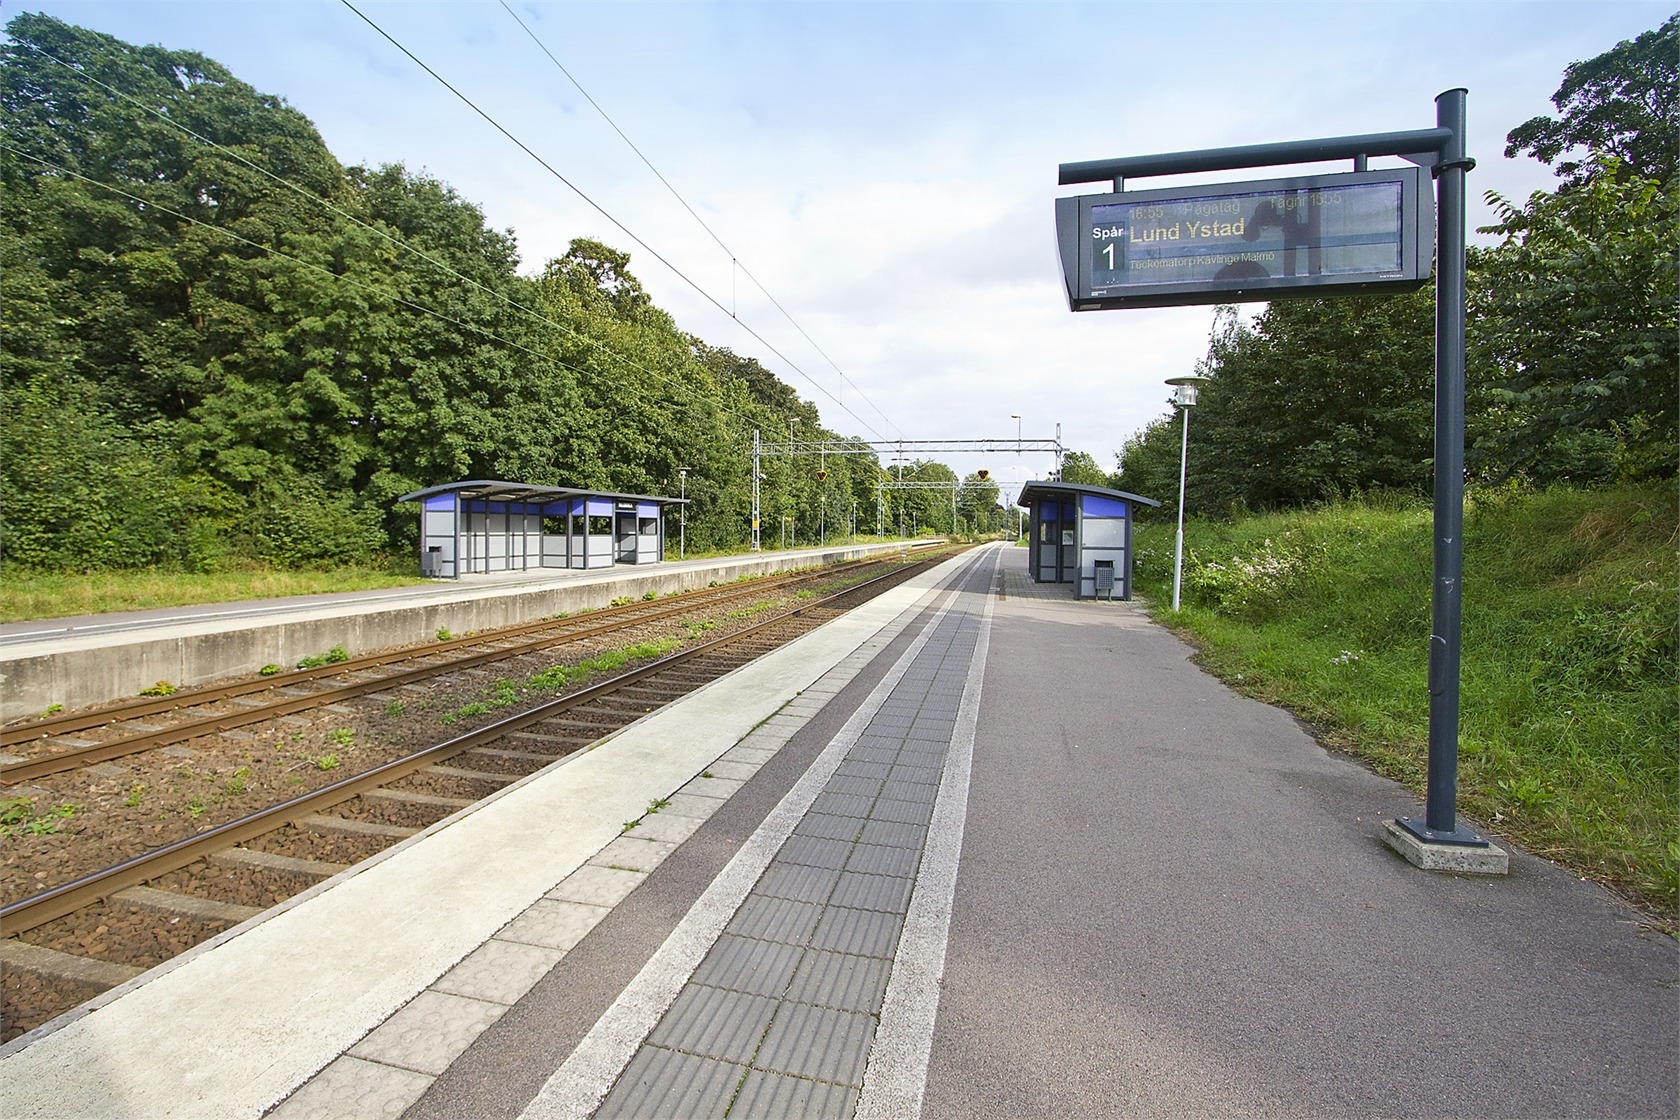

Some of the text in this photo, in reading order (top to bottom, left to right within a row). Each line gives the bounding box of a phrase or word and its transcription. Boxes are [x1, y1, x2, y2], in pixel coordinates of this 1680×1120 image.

[1130, 206, 1163, 220] 16:55
[1092, 226, 1124, 240] Spår
[1130, 217, 1245, 243] Lund Ystad
[1102, 243, 1114, 270] 1
